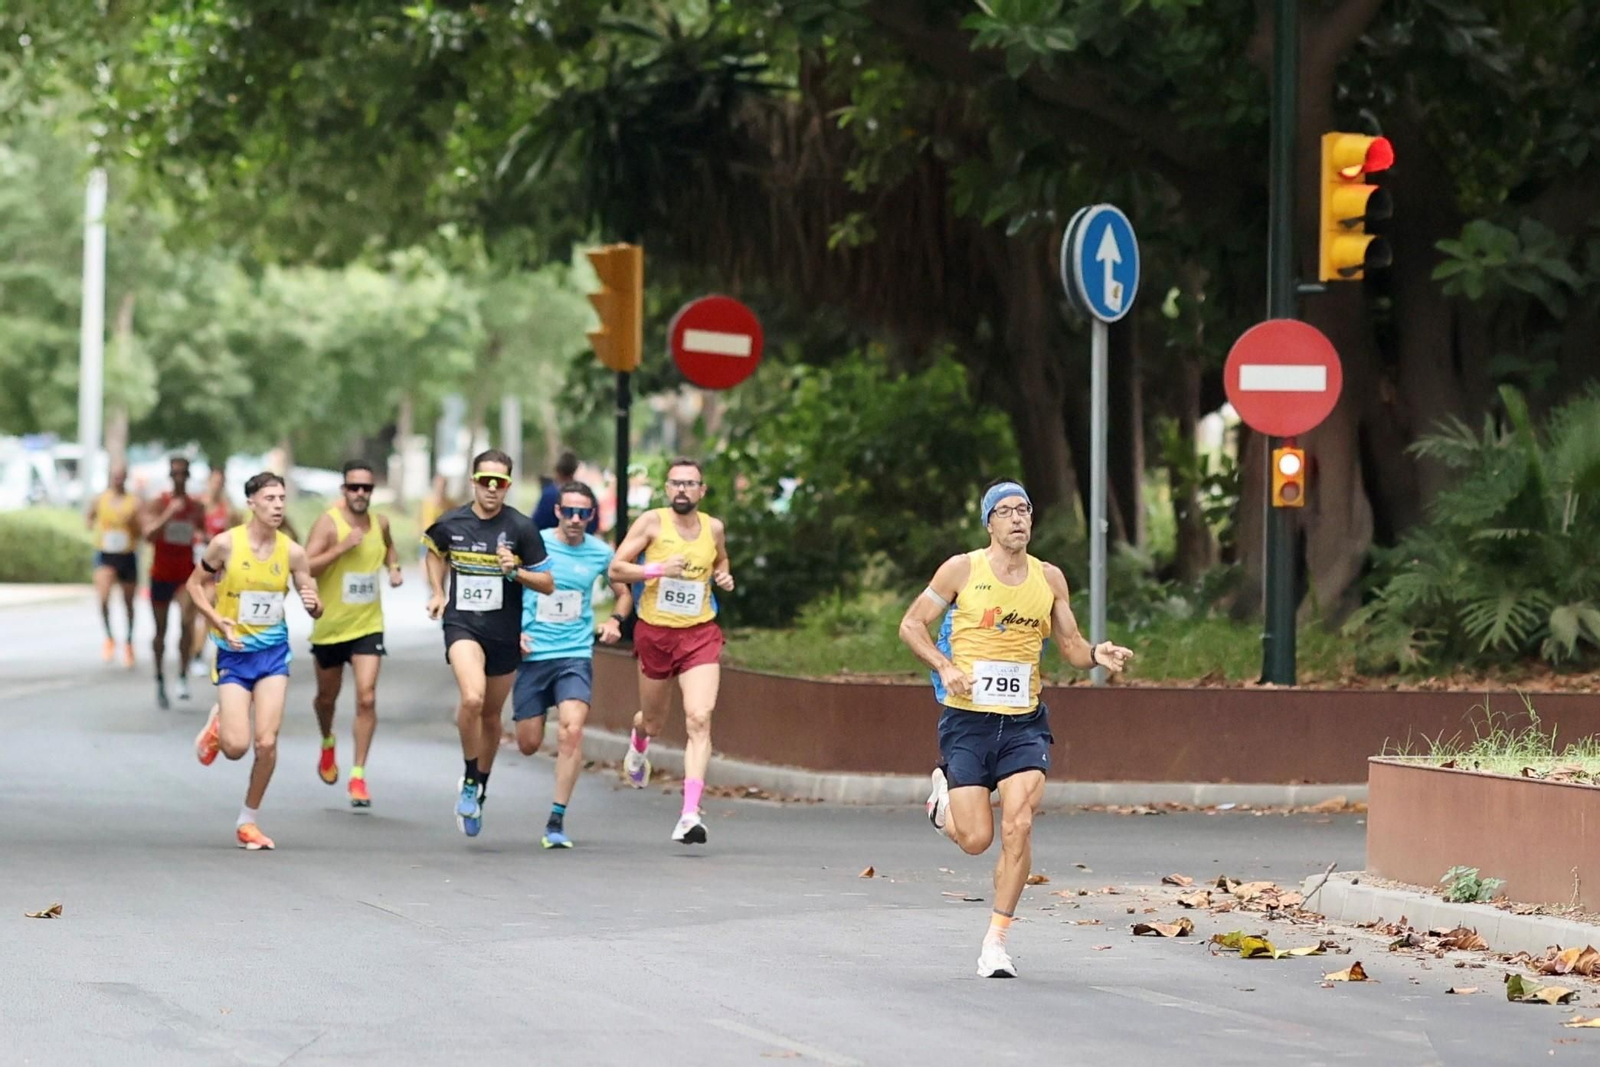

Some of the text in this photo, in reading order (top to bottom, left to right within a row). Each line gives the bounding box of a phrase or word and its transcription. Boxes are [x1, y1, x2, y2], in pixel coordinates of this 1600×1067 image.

[463, 588, 493, 600] 847
[665, 590, 696, 605] 692
[252, 603, 271, 615] 77
[555, 602, 563, 613] 1
[1001, 609, 1040, 628] Álora
[981, 677, 1020, 693] 796
